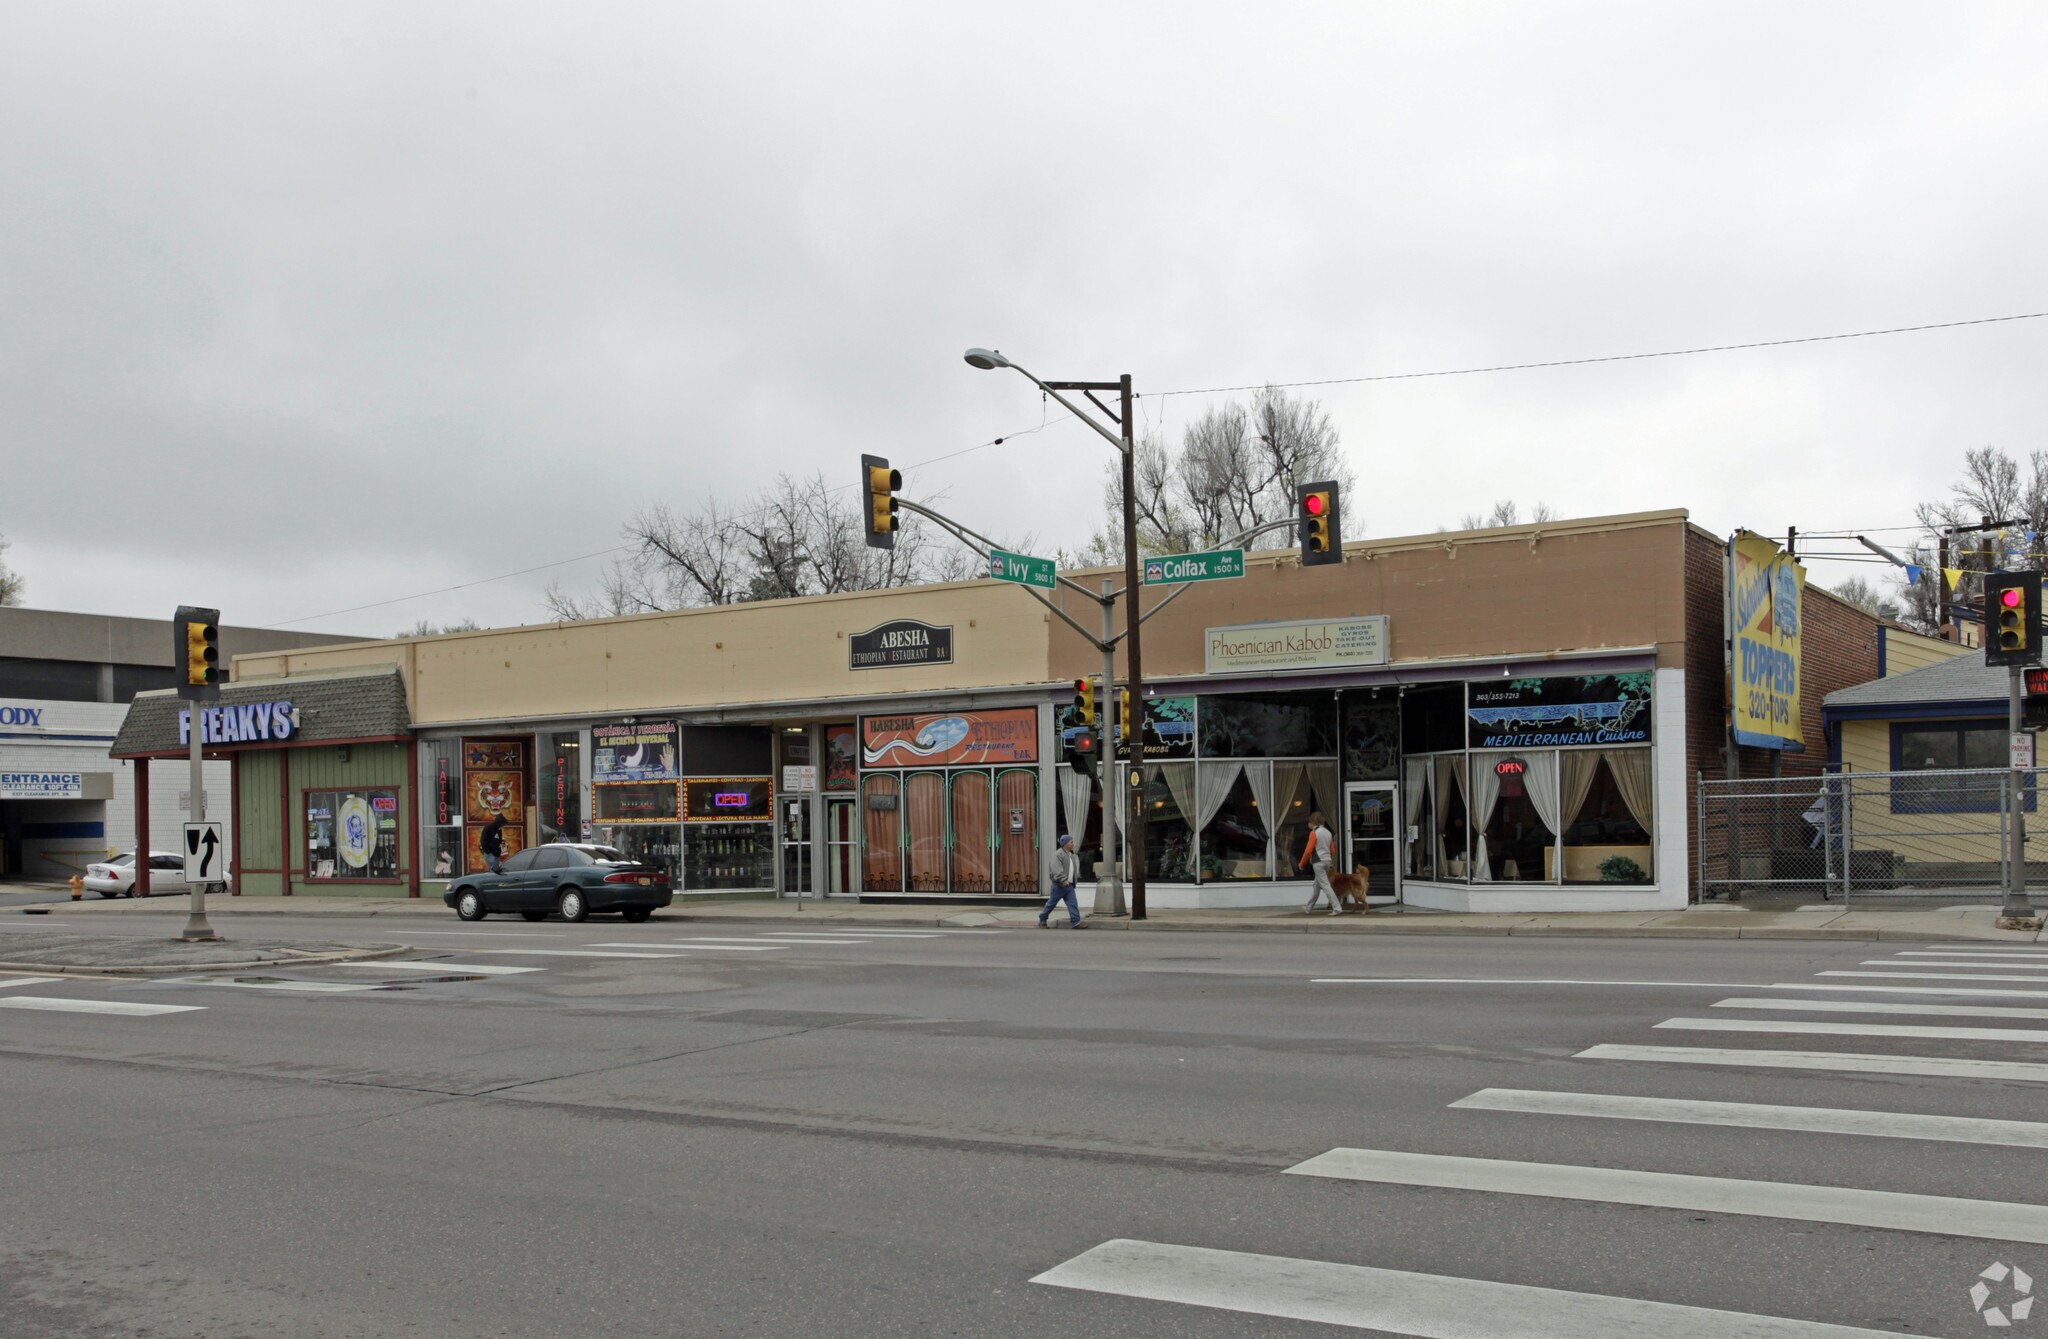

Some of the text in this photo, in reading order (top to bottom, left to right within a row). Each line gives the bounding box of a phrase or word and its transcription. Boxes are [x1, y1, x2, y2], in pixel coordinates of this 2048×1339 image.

[1221, 556, 1232, 564] Ave
[1009, 557, 1029, 582] Ivy
[1042, 564, 1048, 572] ST
[1163, 559, 1207, 579] Colfax
[1214, 564, 1240, 574] 1500 N
[1035, 572, 1053, 584] 5800 E
[1212, 626, 1332, 656] Phoenician Kabob
[1335, 641, 1377, 649] CATERING
[852, 651, 887, 664] ETHIOPIAN
[1740, 638, 1796, 697] TOPPERS
[1476, 691, 1520, 703] 303/355-7213
[1749, 690, 1789, 725] 320-TOPS
[870, 718, 915, 732] HABESHA
[1483, 728, 1646, 747] MEDITERRANEAN Cuisine
[1497, 762, 1523, 774] OPEN
[1, 774, 80, 783] ENTRANCE
[439, 759, 447, 823] TATTOO
[375, 799, 395, 809] OPEN
[717, 795, 745, 804] OPEN
